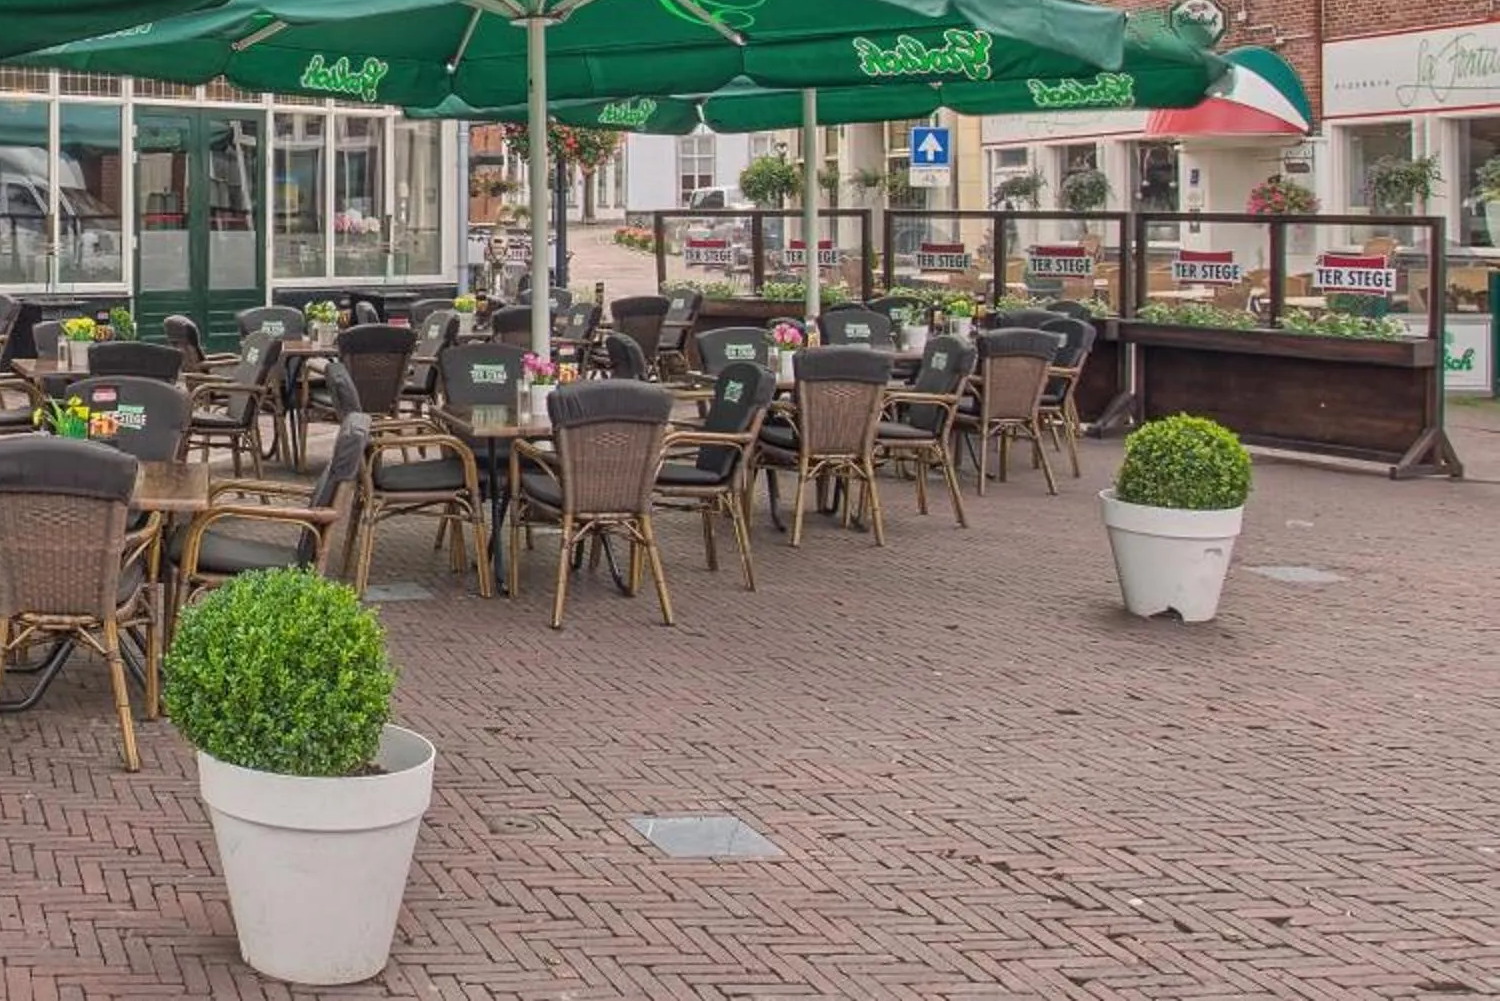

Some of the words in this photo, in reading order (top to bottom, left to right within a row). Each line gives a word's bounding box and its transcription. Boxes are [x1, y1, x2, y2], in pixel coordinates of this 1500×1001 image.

[786, 250, 804, 263] TER
[916, 254, 935, 267] TER
[938, 254, 969, 269] STEGE
[1030, 258, 1051, 272] TER
[1055, 258, 1092, 274] STEGE
[1174, 262, 1198, 278] TER
[1202, 264, 1239, 280] STEGE
[1318, 270, 1344, 286] TER
[1349, 270, 1393, 288] STEGE
